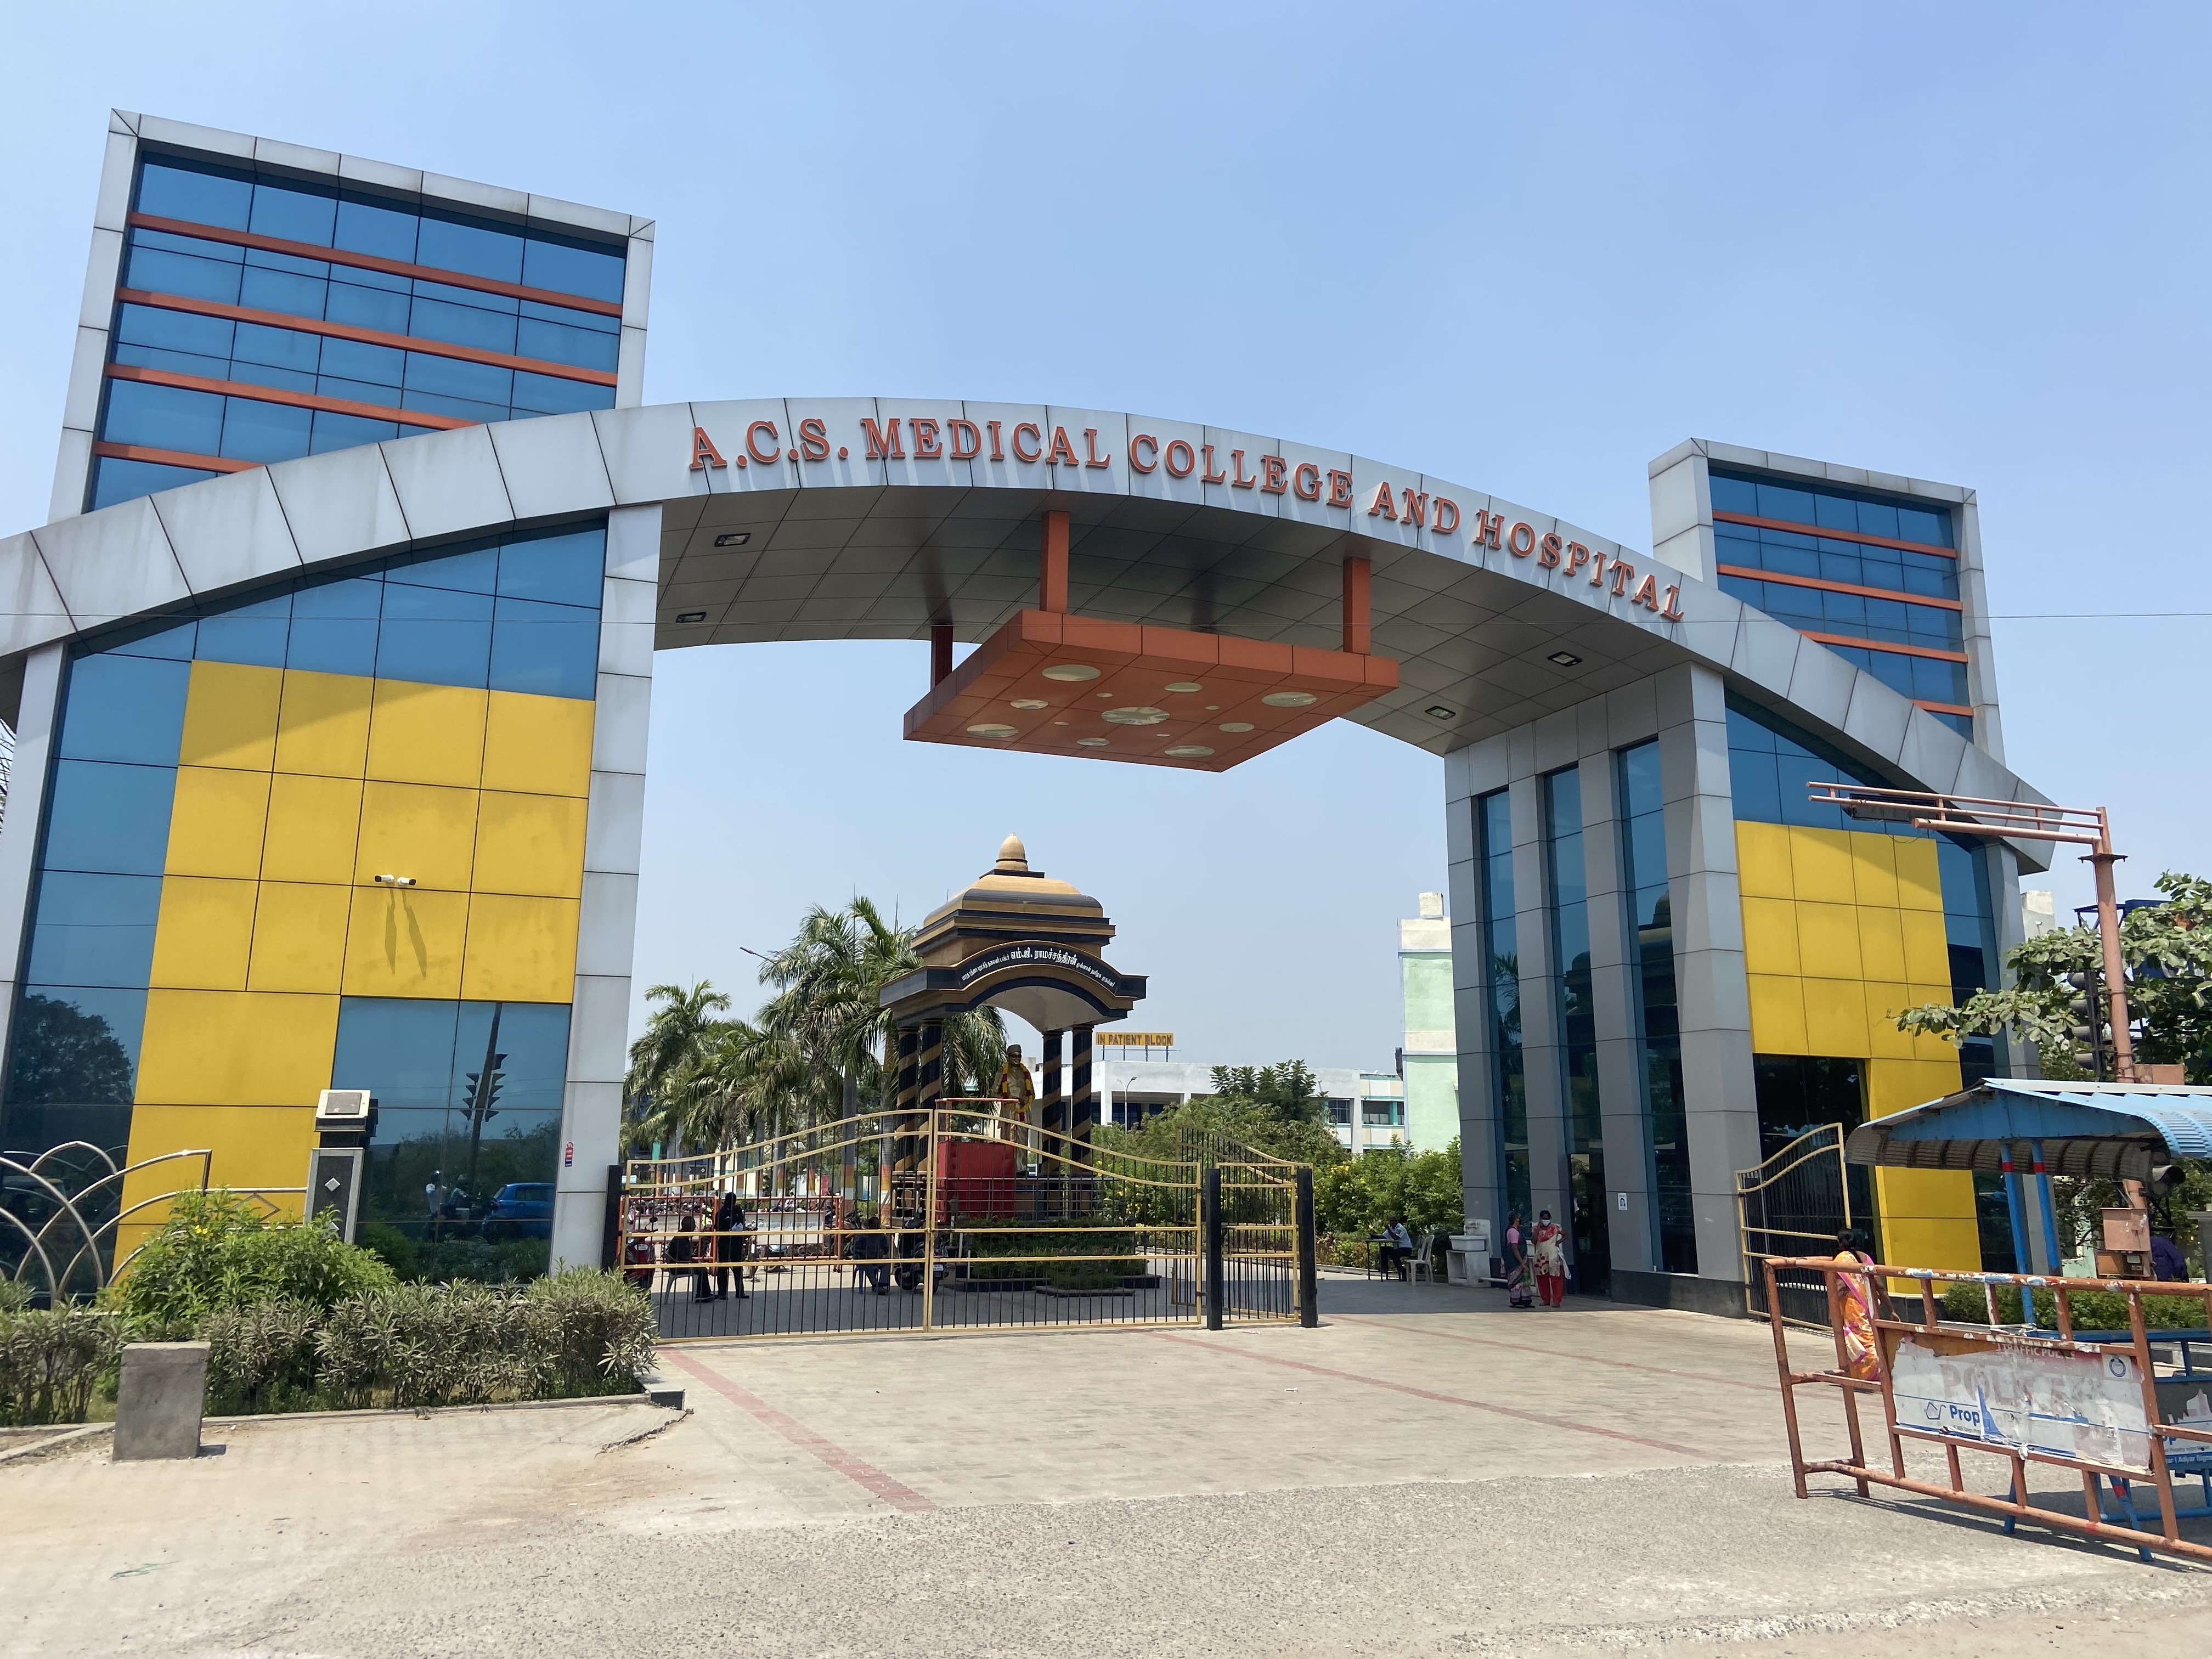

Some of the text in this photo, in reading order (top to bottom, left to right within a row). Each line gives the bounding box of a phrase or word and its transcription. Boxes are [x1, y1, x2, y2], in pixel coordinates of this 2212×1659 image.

[690, 417, 1685, 622] A.C.S. MEDICAL COLLEGE AND HOSPITAL
[1098, 1034, 1105, 1045] IN
[1108, 1034, 1142, 1046] PATIENT
[2002, 1342, 2040, 1357] TRAFFIC
